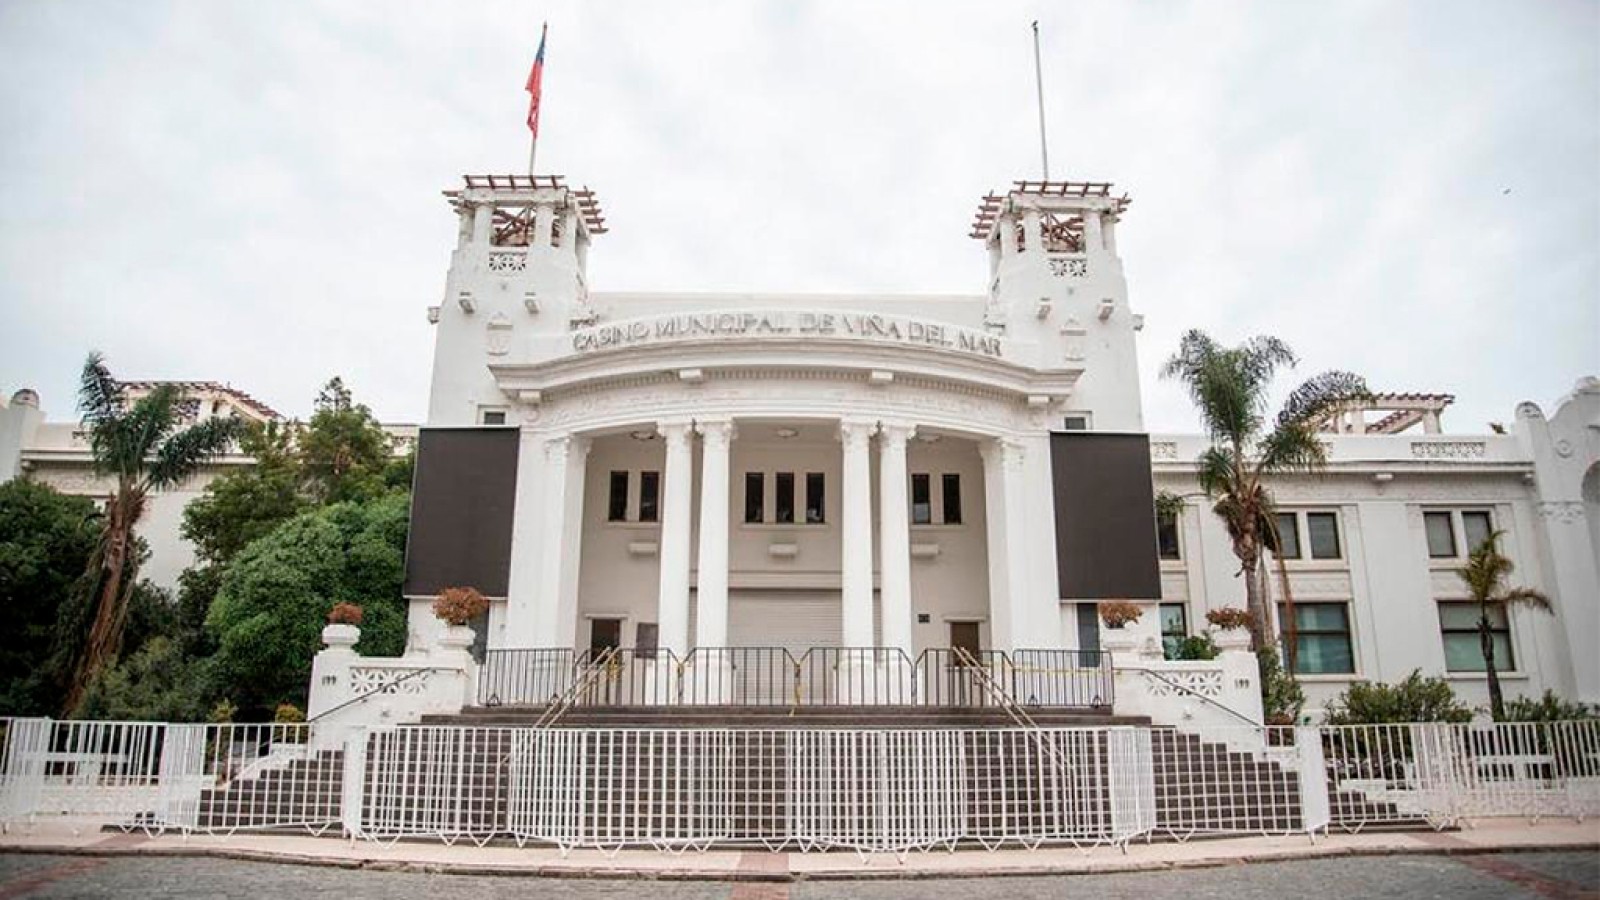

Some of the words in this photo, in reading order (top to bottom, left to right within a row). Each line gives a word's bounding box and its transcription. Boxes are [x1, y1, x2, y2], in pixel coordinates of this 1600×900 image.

[573, 322, 650, 350] CASINO
[655, 313, 791, 337] MUNICIPAL
[799, 313, 836, 334] DE
[842, 313, 901, 339] VIÑA
[908, 320, 953, 346] DEL
[958, 329, 1001, 356] MAR
